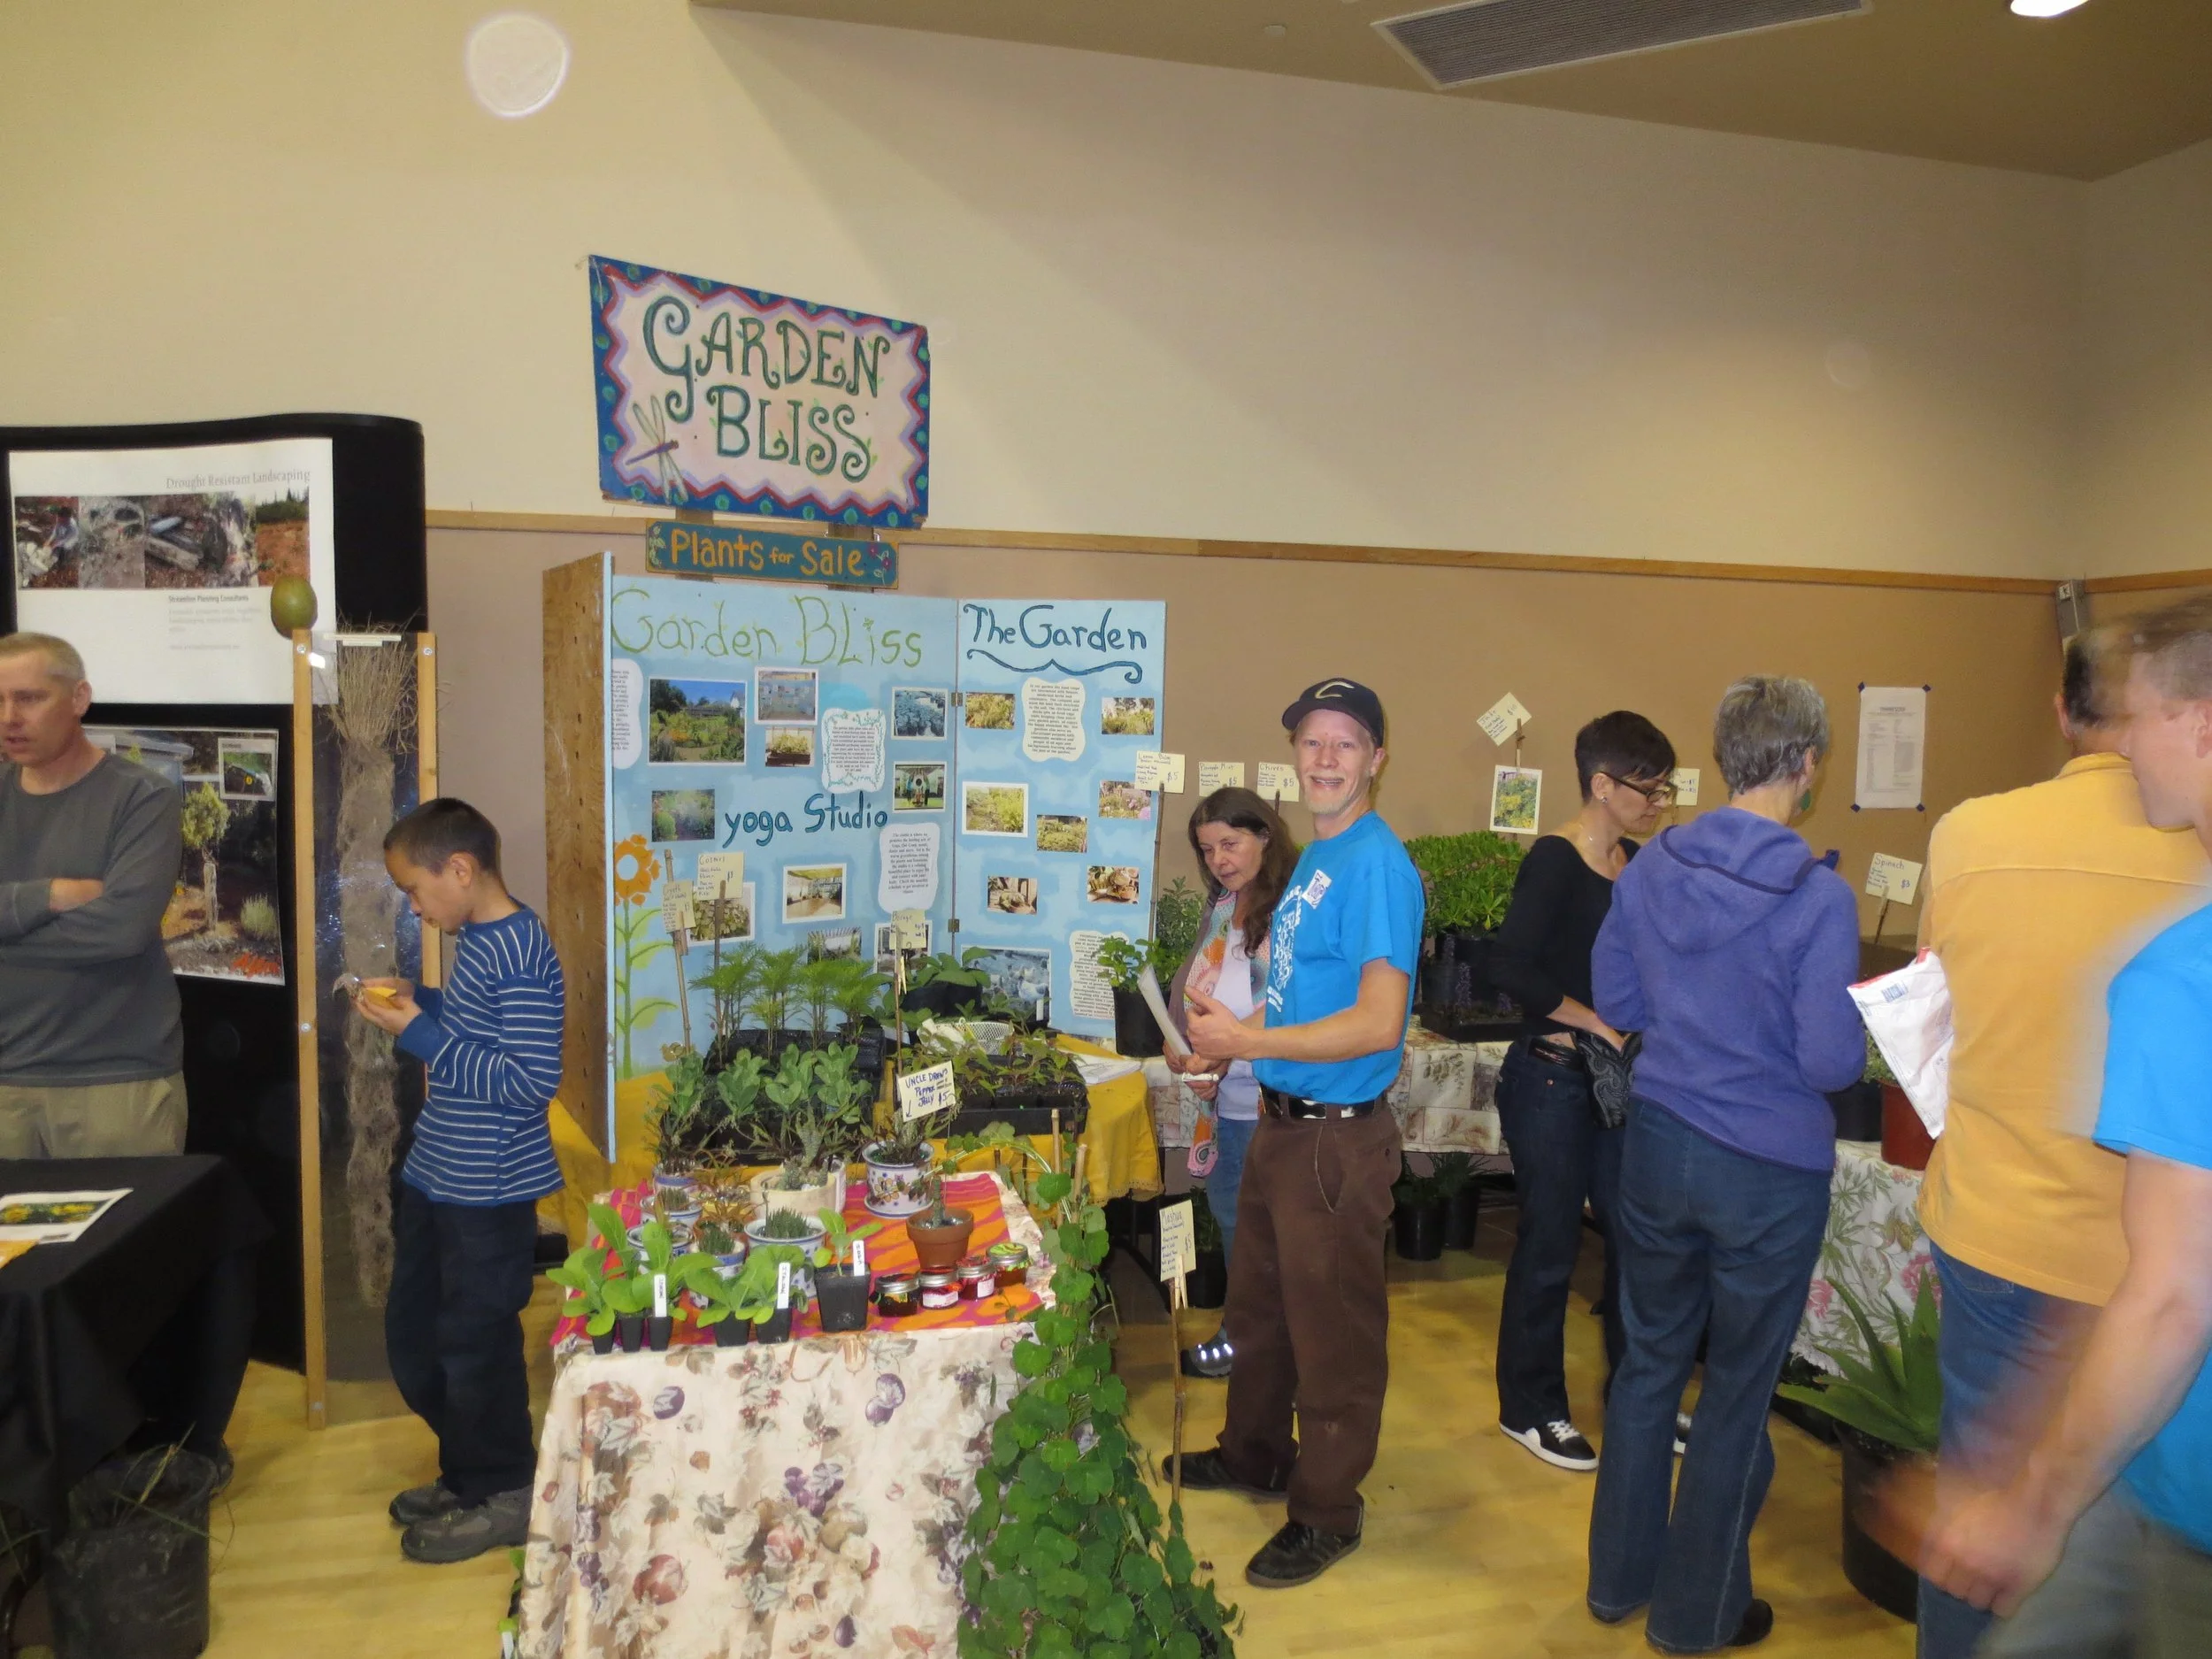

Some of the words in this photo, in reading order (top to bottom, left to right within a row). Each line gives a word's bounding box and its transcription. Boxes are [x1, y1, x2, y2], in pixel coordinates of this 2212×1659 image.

[642, 296, 890, 423] GARDEN
[706, 384, 872, 483] BLISS
[166, 474, 205, 489] Drought
[208, 472, 250, 487] Resistant
[252, 469, 311, 484] Landscaping
[670, 528, 764, 571] Plants
[769, 546, 795, 564] for
[800, 536, 864, 577] Sale
[611, 588, 777, 658] Garden
[963, 603, 1017, 644] The
[1019, 604, 1147, 652] Garden
[722, 810, 794, 849] yoga
[804, 790, 888, 833] Studio
[905, 1073, 926, 1088] UNCLE
